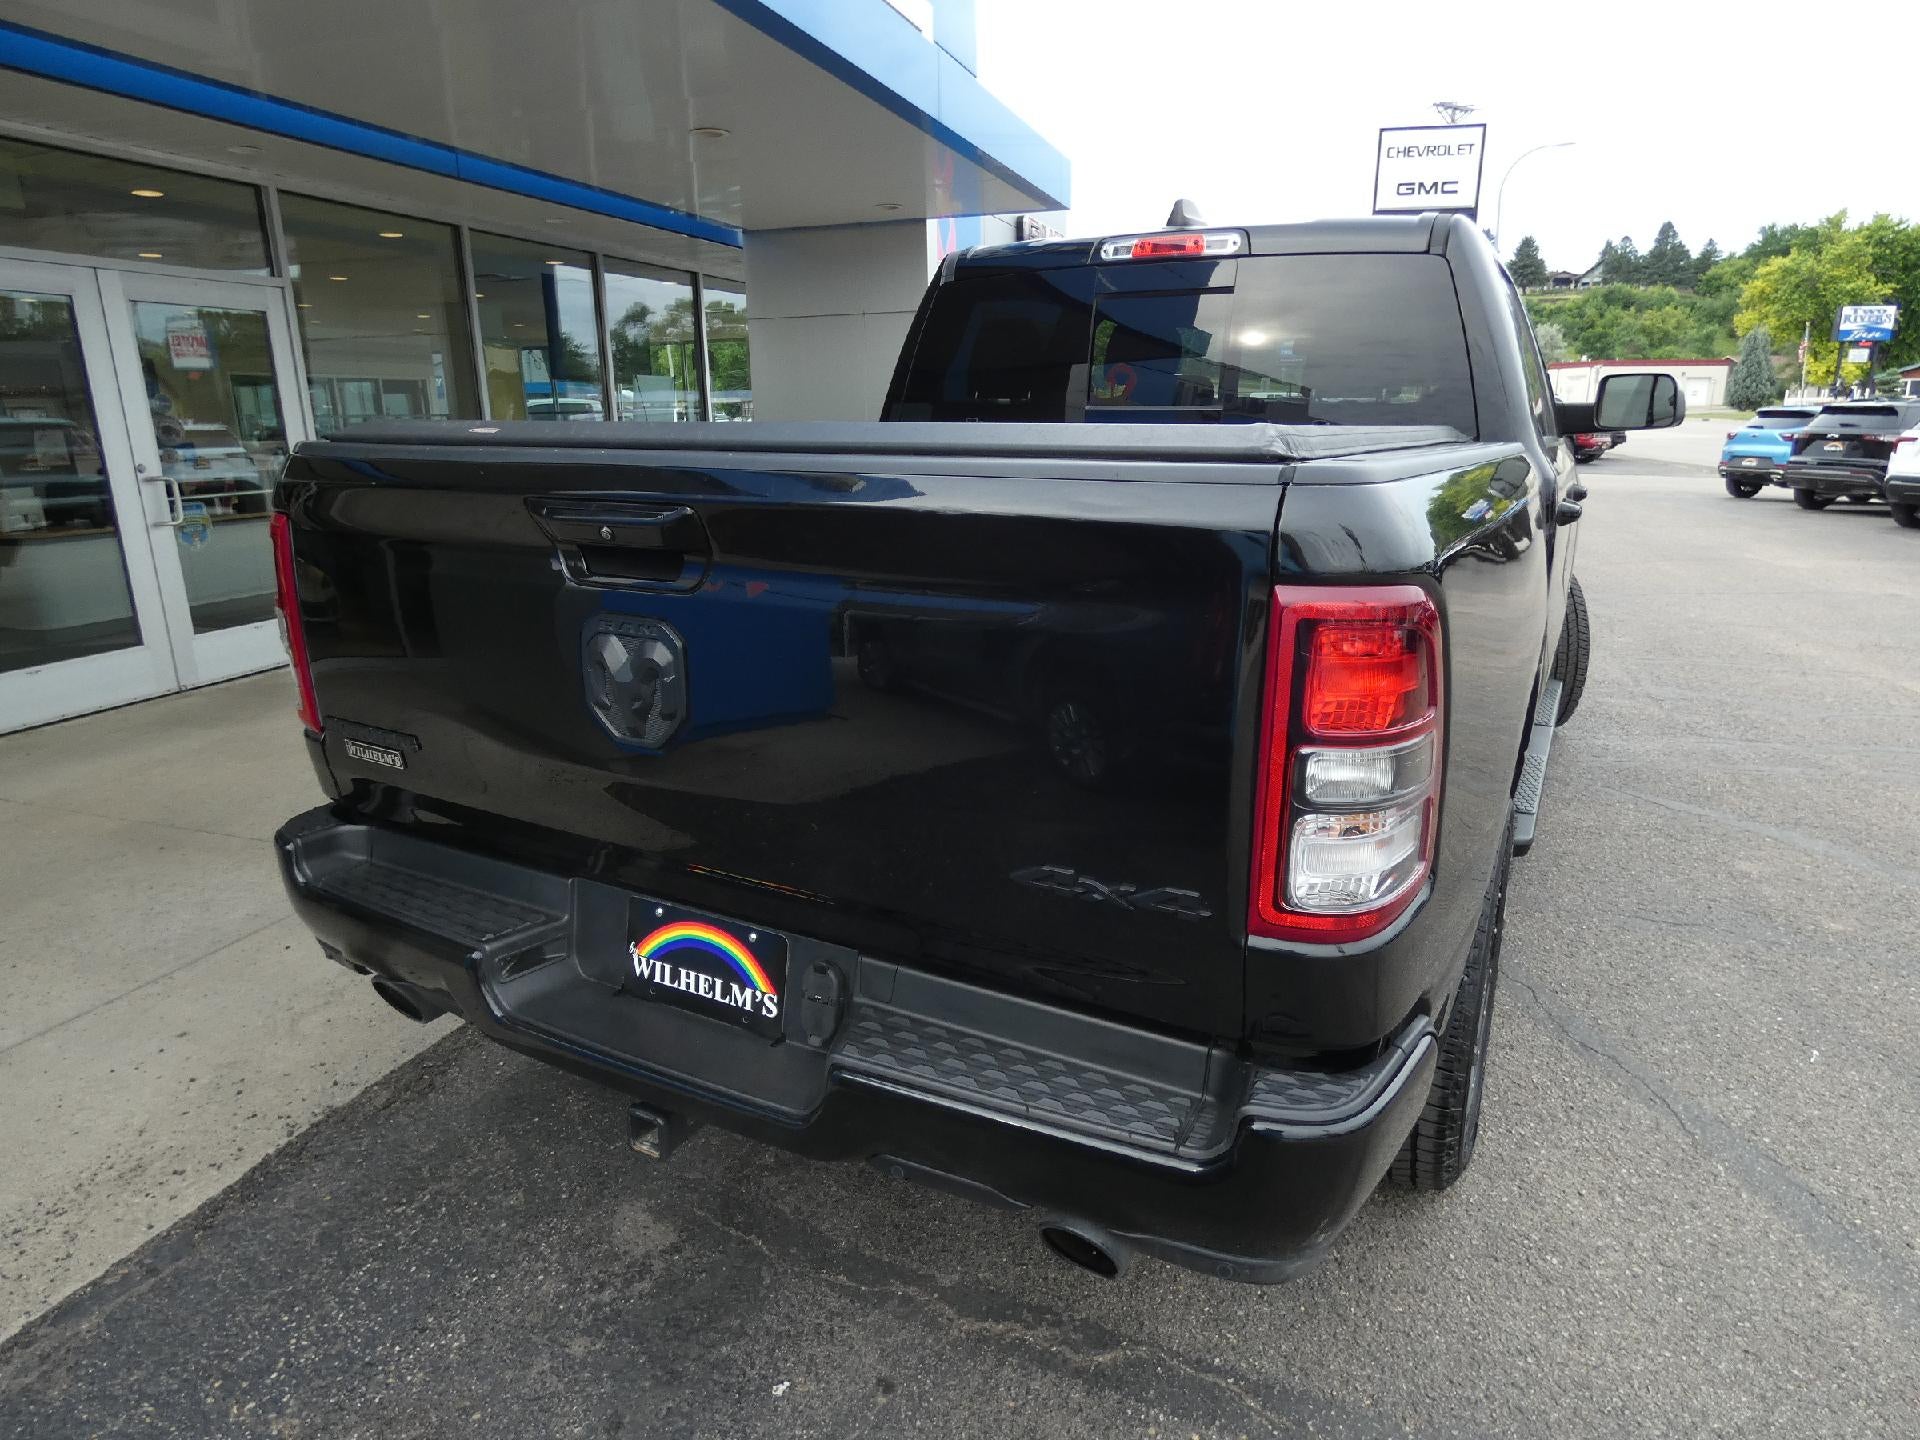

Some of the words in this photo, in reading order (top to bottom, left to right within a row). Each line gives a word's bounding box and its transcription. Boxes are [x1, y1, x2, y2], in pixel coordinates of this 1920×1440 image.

[1386, 143, 1475, 159] CHEVROLET
[1396, 181, 1459, 196] GMC
[346, 742, 402, 767] WILHELM'S
[632, 955, 779, 1019] WILHELM'S
